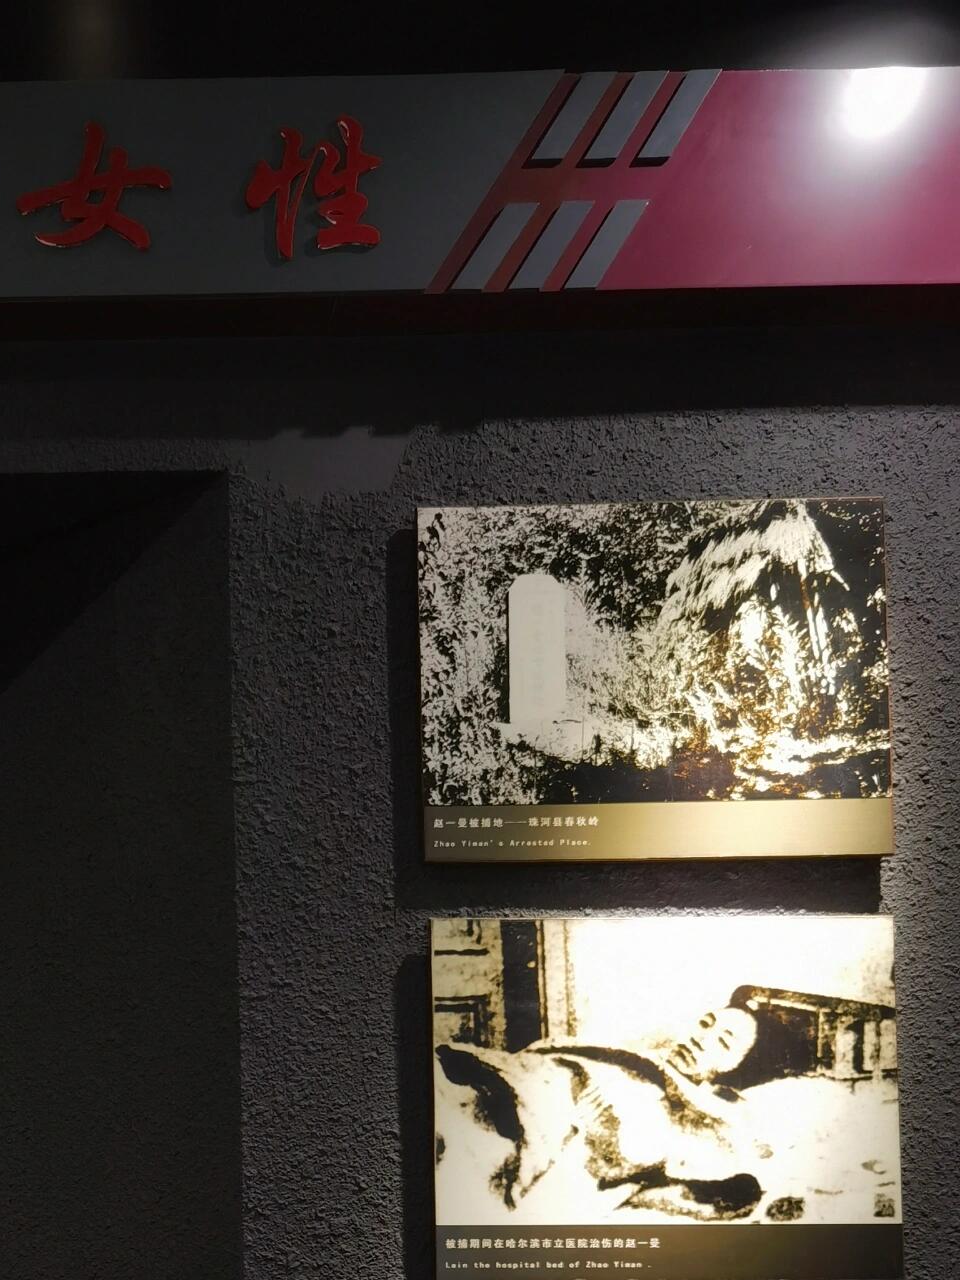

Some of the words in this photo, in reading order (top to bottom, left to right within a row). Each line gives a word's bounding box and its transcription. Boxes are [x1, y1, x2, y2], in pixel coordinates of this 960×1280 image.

[433, 840, 456, 848] Zhao
[509, 839, 555, 847] Arrested
[445, 1237, 661, 1249] 被捕期间在哈尔滨市立医院治伤的赵一曼
[473, 1261, 491, 1269] the
[495, 1261, 540, 1269] hospital
[546, 1261, 564, 1269] bed
[568, 1261, 580, 1269] of
[585, 1261, 609, 1269] Zhao
